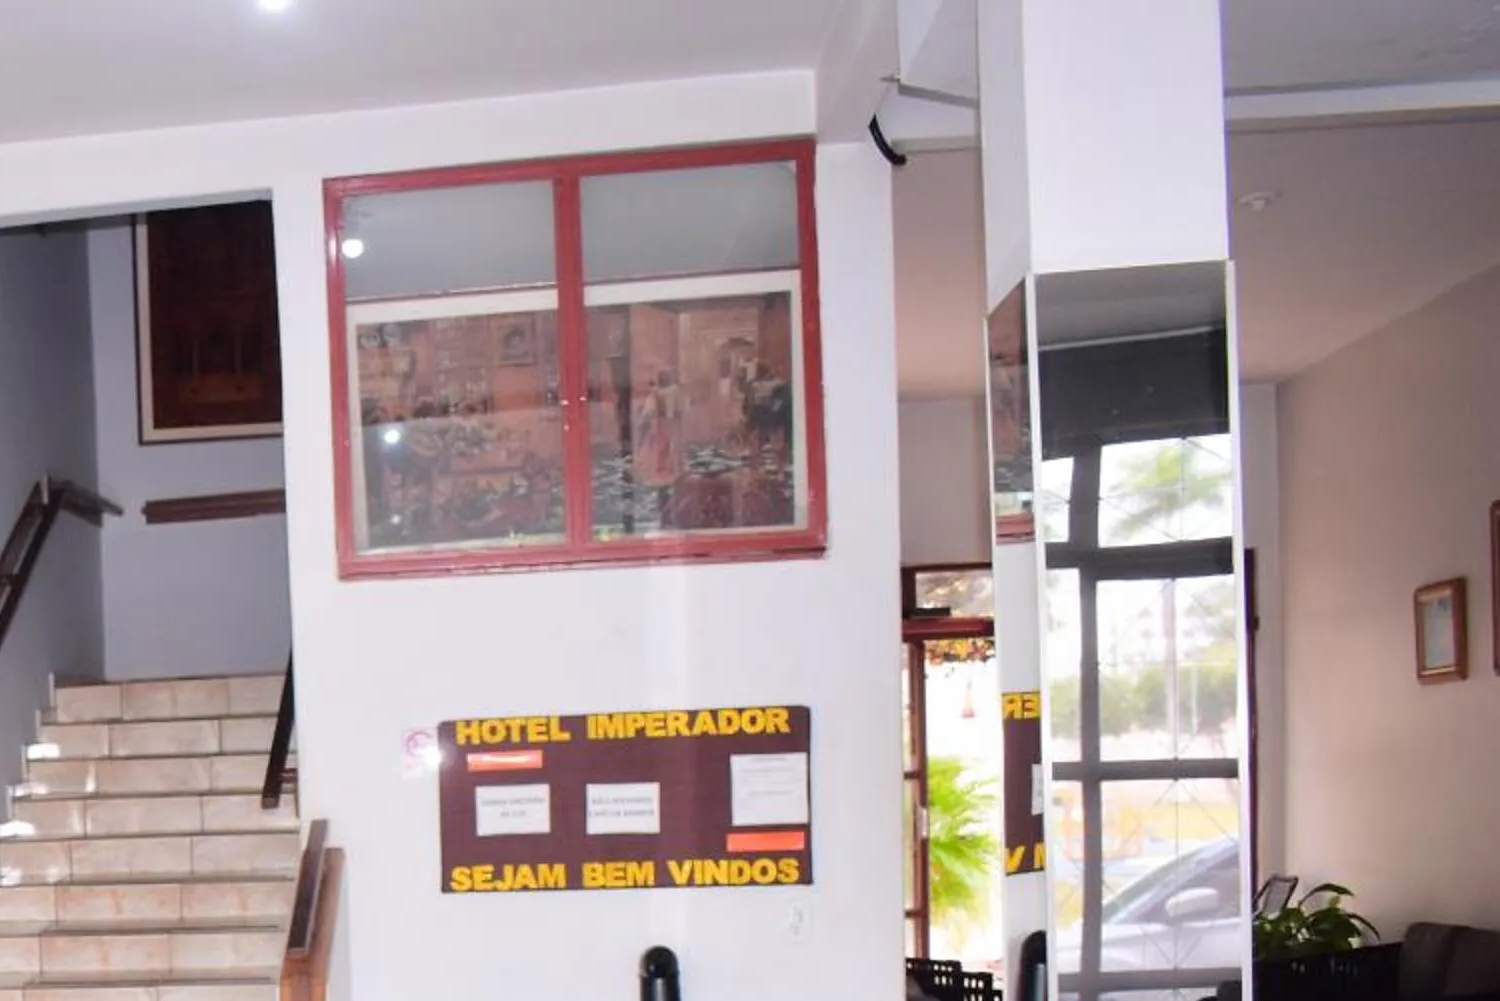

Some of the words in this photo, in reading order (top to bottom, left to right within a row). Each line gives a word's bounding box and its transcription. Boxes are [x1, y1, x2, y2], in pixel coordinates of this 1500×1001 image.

[455, 716, 572, 745] HOTEL
[586, 706, 791, 740] IMPERADOR
[450, 863, 567, 891] SEJAM
[581, 860, 656, 888] BEM
[667, 857, 800, 886] VINDOS
